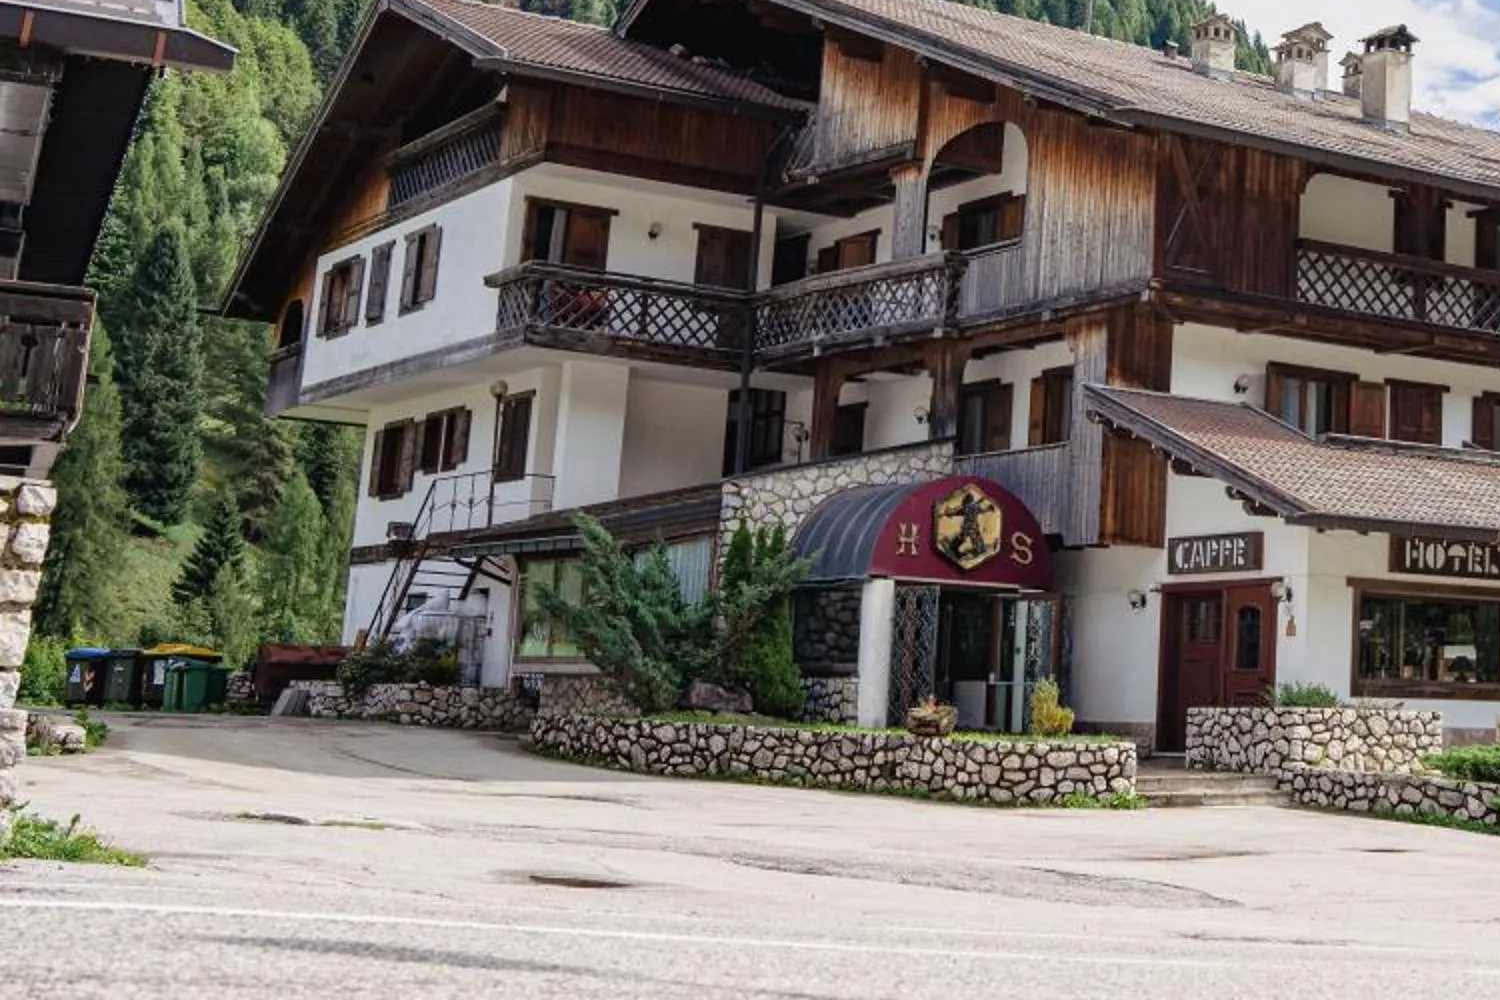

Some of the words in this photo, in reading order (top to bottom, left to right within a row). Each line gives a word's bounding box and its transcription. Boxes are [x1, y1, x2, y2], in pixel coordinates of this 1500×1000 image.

[896, 523, 918, 555] H
[1010, 531, 1033, 564] S
[1405, 539, 1500, 573] HOTEL
